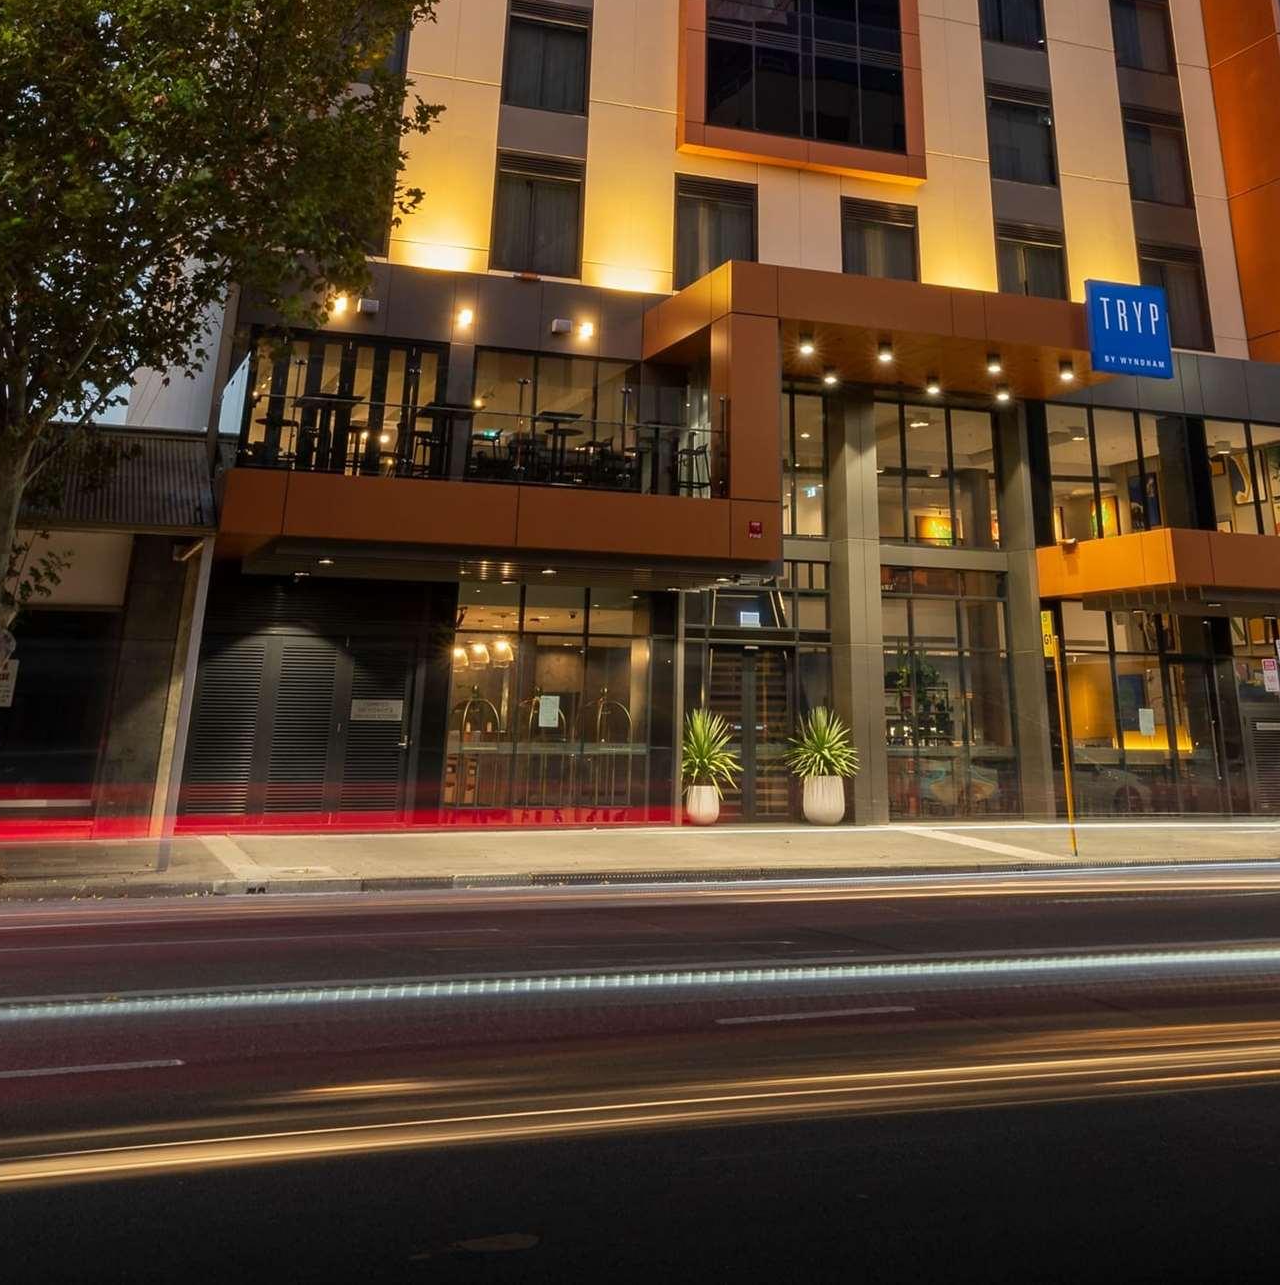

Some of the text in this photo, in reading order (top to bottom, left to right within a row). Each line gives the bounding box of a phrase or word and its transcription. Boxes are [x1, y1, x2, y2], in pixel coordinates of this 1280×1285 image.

[1099, 297, 1160, 335] TRYP
[1104, 355, 1165, 369] BY WYNDHAM
